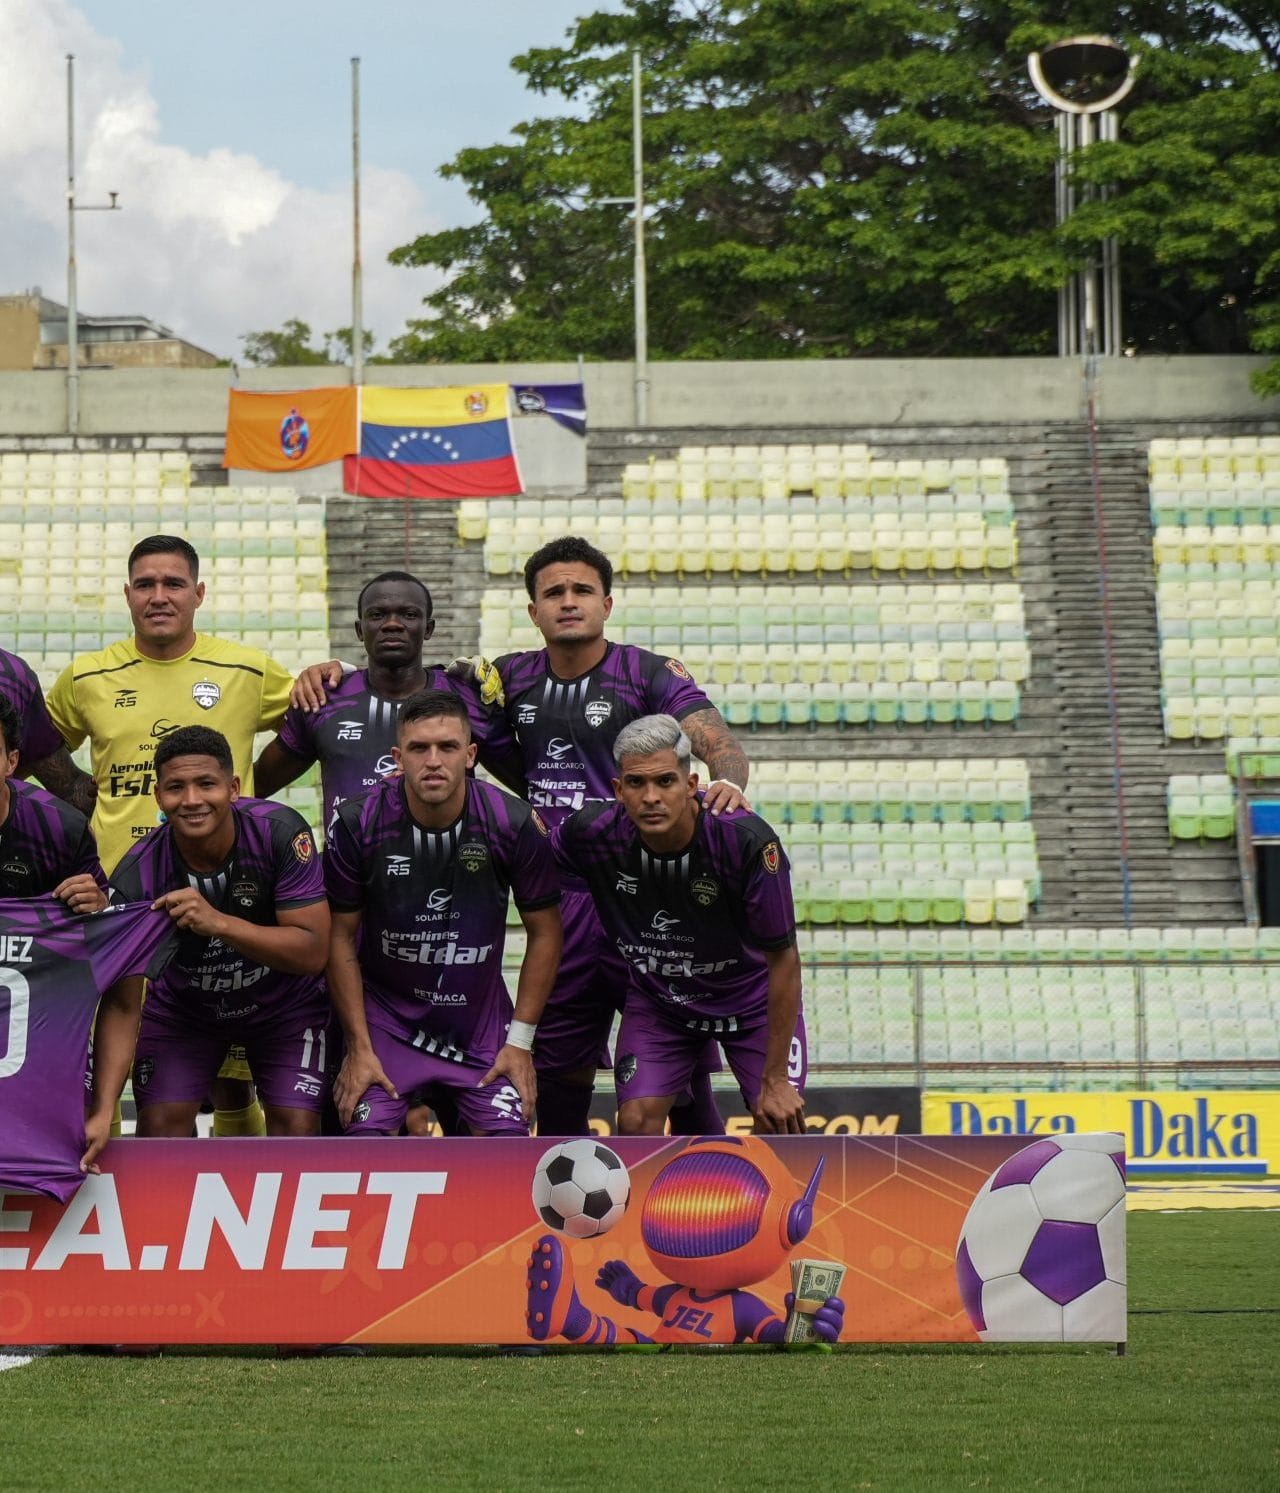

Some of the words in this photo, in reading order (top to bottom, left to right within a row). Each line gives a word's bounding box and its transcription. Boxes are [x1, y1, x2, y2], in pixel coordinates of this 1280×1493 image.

[300, 1027, 326, 1073] 11
[1127, 1097, 1258, 1159] Daka
[662, 1304, 715, 1339] JEL
